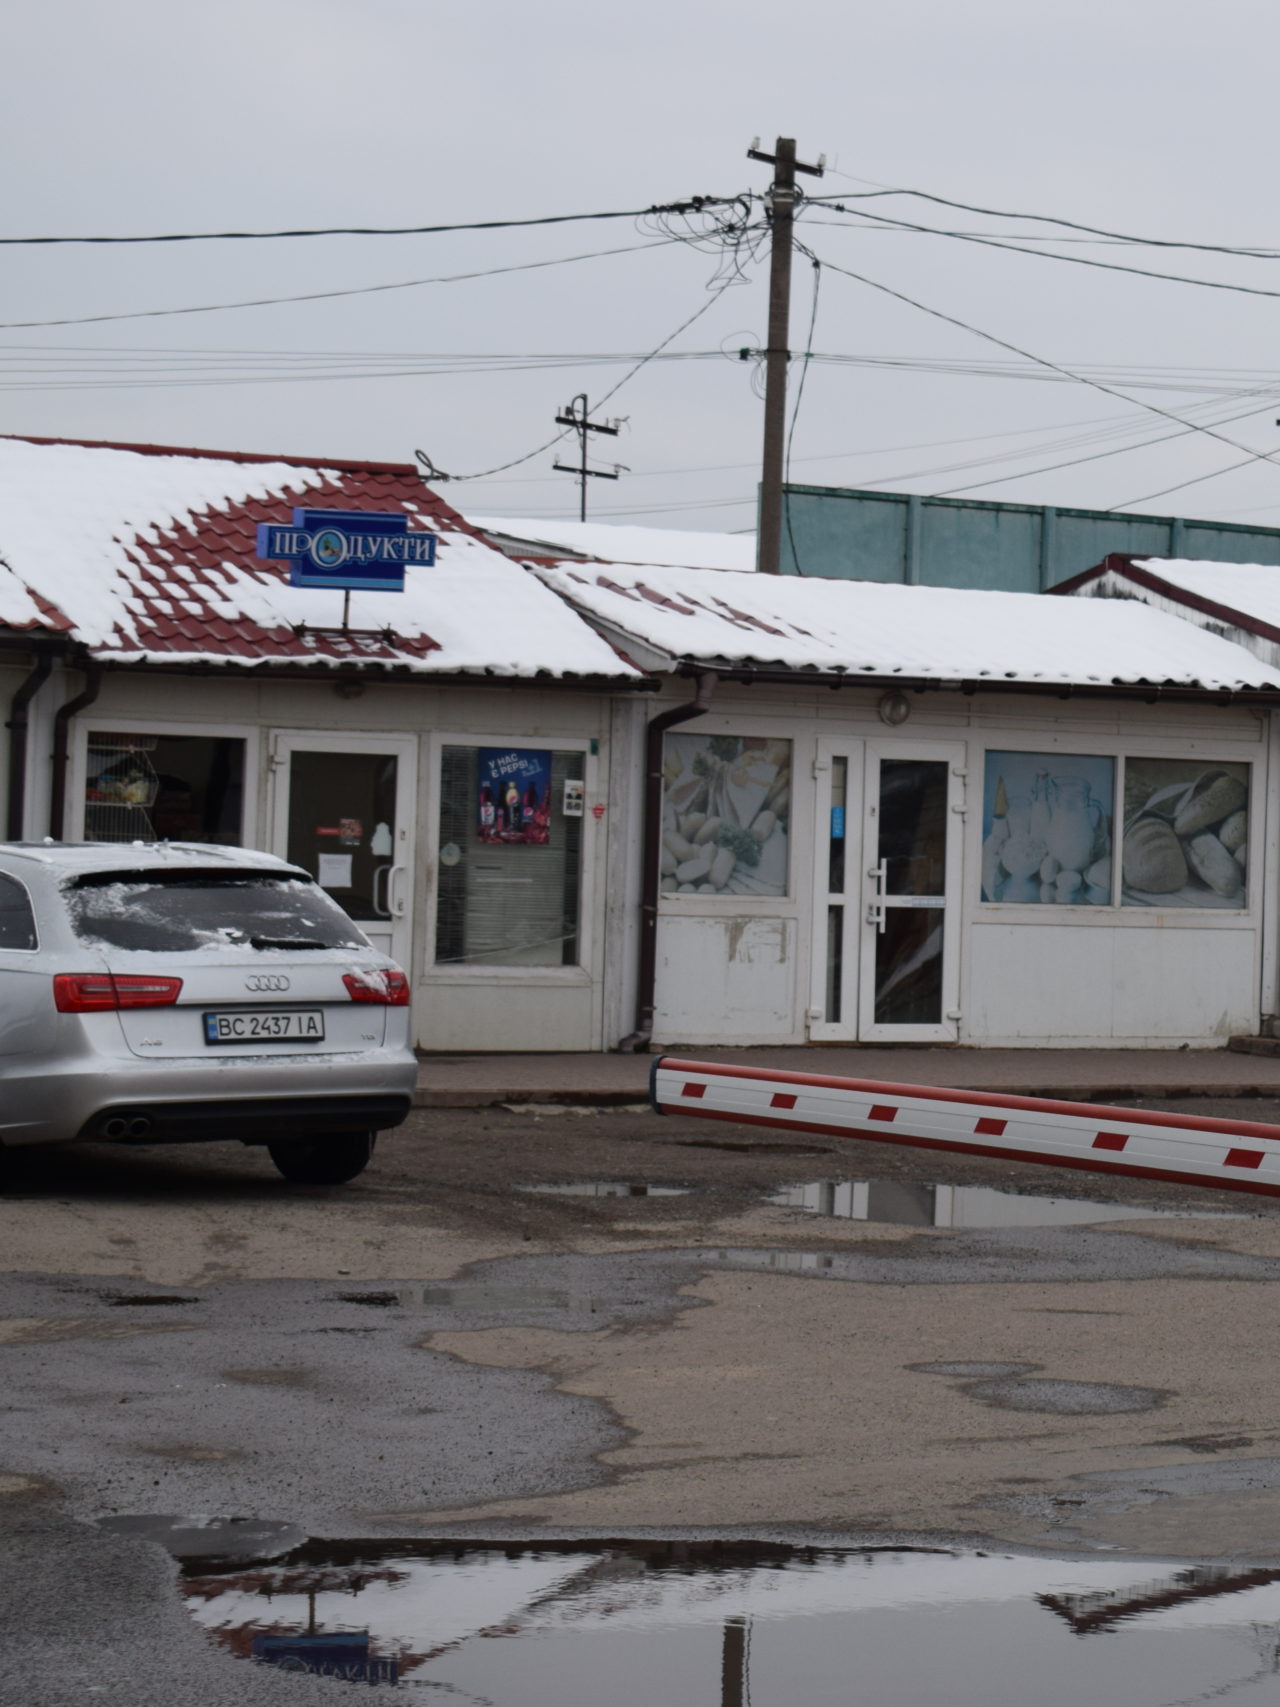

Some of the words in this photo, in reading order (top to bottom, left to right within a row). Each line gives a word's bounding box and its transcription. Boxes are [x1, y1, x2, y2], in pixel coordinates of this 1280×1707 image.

[275, 529, 430, 567] ПРОДУКТИ
[497, 753, 518, 767] НАС
[500, 760, 528, 775] PEPSI
[219, 1018, 246, 1036] BC
[250, 1016, 291, 1035] 2437
[298, 1016, 319, 1034] IA
